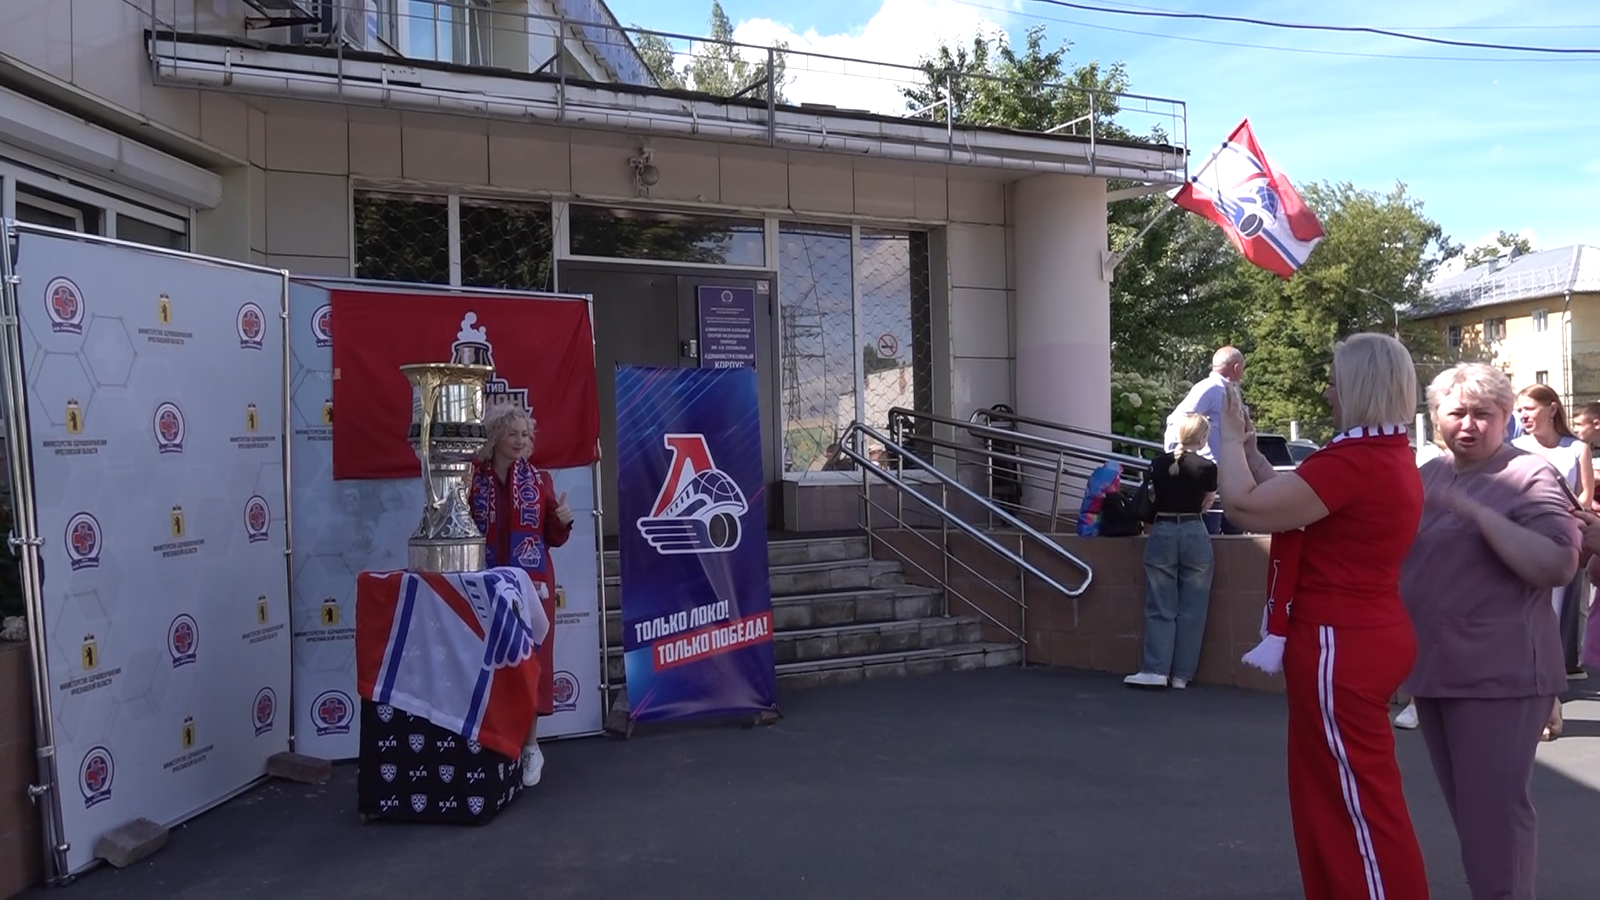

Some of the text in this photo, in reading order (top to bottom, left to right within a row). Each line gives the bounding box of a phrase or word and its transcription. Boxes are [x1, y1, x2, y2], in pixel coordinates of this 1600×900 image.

[714, 361, 744, 369] КОРПУС
[634, 600, 730, 643] ТОЛЬКО ЛОКО!
[658, 616, 768, 665] ТОЛЬКО ПОБЕДА!
